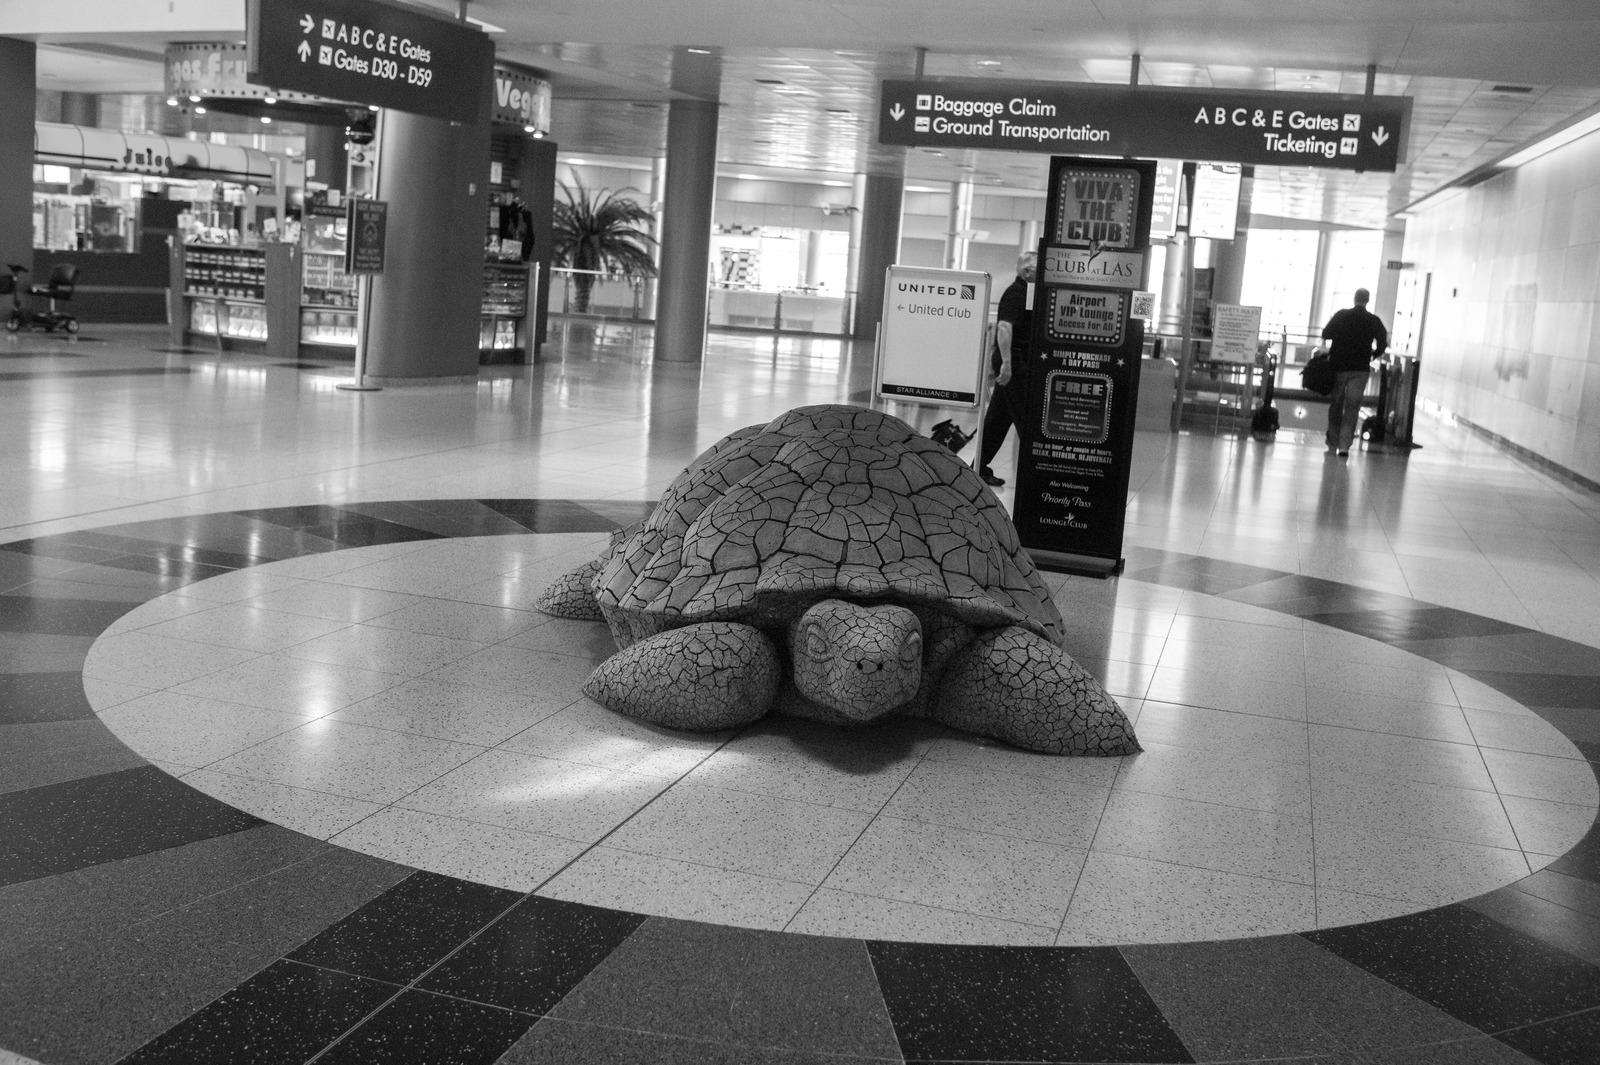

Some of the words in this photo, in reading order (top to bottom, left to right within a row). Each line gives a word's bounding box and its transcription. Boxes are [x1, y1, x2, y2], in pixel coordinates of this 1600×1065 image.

[336, 23, 348, 44] A
[350, 26, 360, 46] B
[362, 29, 374, 49] C
[376, 32, 386, 52] &
[388, 35, 398, 55] E
[400, 38, 432, 63] Gates
[334, 48, 369, 74] Gates
[372, 56, 398, 80] D30
[408, 65, 433, 88] D59
[934, 94, 1004, 118] Baggage
[1008, 98, 1056, 117] Claim
[1194, 106, 1210, 124] A
[1214, 107, 1226, 125] B
[1231, 108, 1248, 126] C
[1252, 109, 1266, 128] &
[1272, 110, 1284, 128] E
[1288, 110, 1339, 132] Gates
[932, 116, 994, 136] Ground
[998, 120, 1110, 142] Transportation
[1264, 132, 1338, 158] Ticketing
[1074, 180, 1122, 202] VIVA
[1079, 200, 1116, 222] THE
[1068, 220, 1122, 242] CLUB
[1044, 256, 1086, 274] CLUB
[1103, 262, 1133, 277] LAS
[898, 282, 957, 296] UNITED
[1070, 294, 1106, 307] Airport
[908, 304, 944, 316] United
[947, 306, 972, 318] Club
[1060, 305, 1076, 317] VIP
[1080, 307, 1114, 321] Lounge
[1058, 319, 1086, 329] Access
[1088, 321, 1100, 330] For
[1102, 322, 1114, 332] All
[1053, 350, 1076, 359] SIMPLY
[1078, 352, 1111, 362] PURCHASE
[1068, 359, 1081, 367] DAY
[1082, 360, 1100, 369] PASS
[916, 388, 950, 398] ALLIANCE
[1055, 381, 1103, 396] FREE
[1032, 449, 1050, 457] RELAX,
[1052, 451, 1077, 460] REFRESH,
[1079, 454, 1112, 464] REJUVENATE
[1062, 482, 1089, 492] Welcoming
[1041, 492, 1070, 507] Priority
[1072, 496, 1091, 507] Pass
[1040, 517, 1066, 526] LOUNGE
[1070, 520, 1087, 529] CLUB
